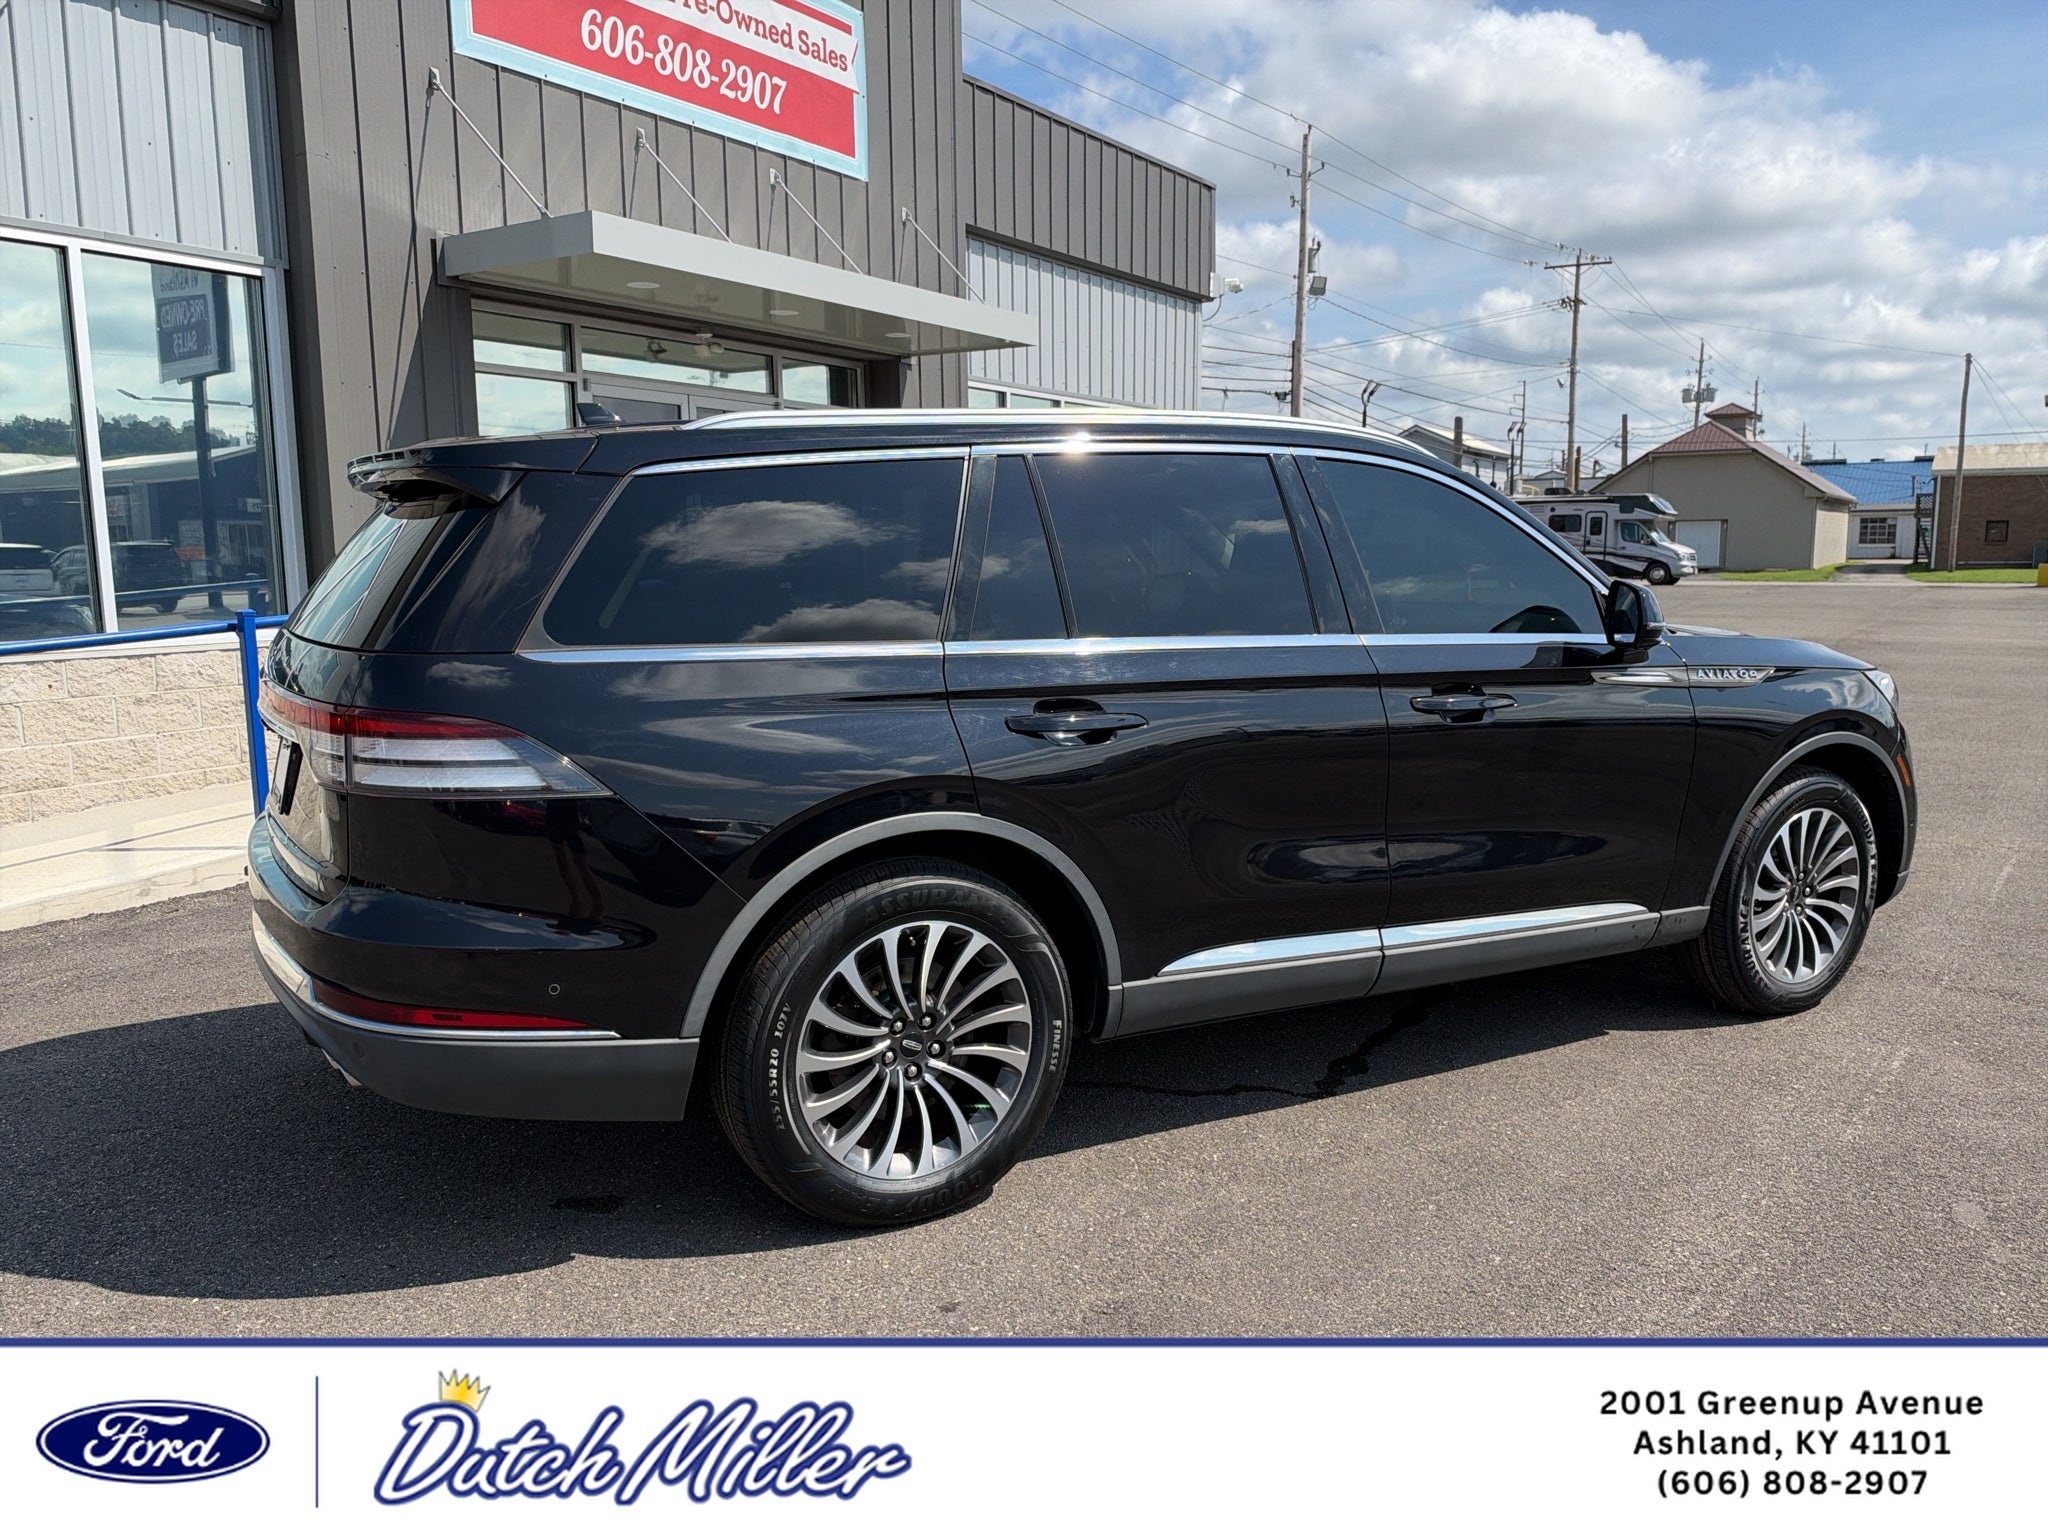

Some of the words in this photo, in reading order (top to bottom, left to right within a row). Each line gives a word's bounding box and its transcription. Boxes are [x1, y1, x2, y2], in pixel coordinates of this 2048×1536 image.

[580, 8, 788, 115] 606-808-2907
[798, 29, 849, 72] Sales
[1696, 668, 1758, 680] AVIATOR
[774, 1002, 791, 1039] 107V
[1048, 1019, 1063, 1074] FINESSE
